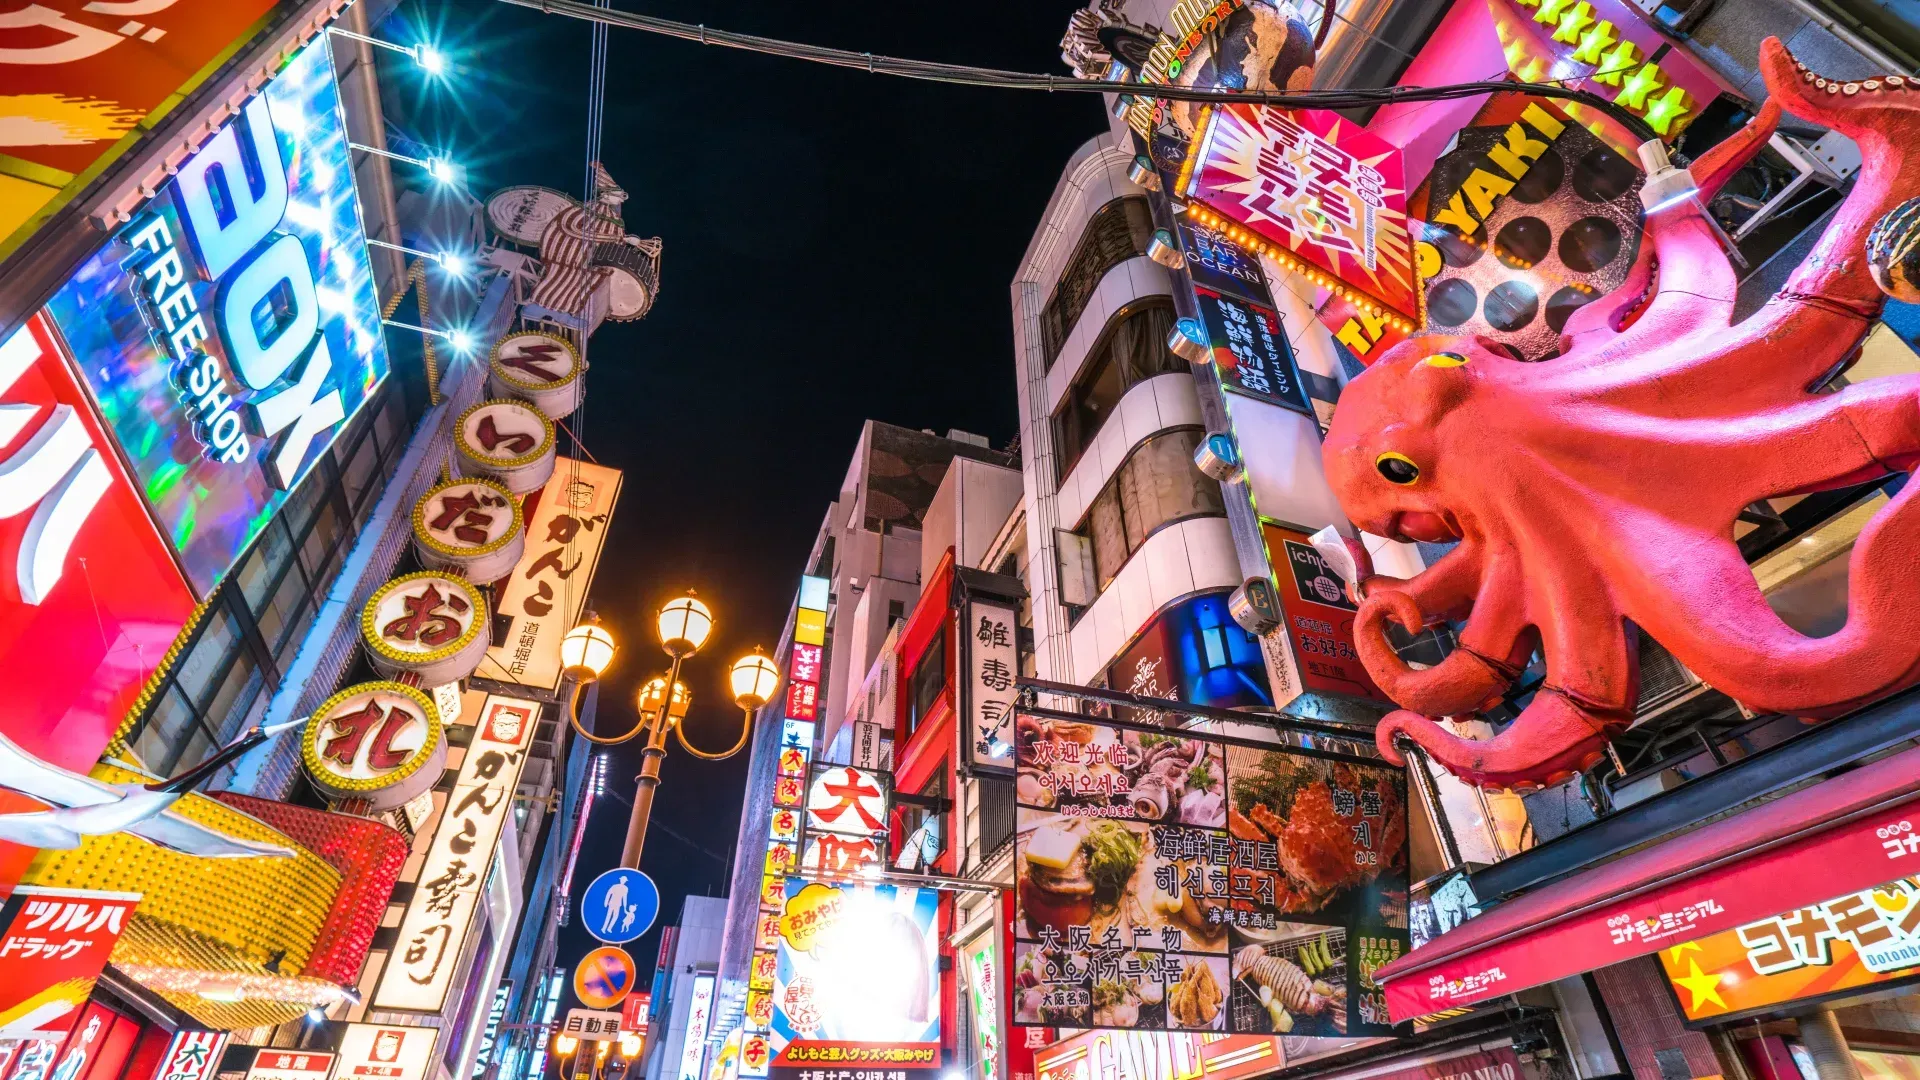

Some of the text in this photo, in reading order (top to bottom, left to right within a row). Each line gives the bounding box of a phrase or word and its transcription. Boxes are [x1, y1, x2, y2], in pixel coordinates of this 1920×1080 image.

[1196, 238, 1240, 260] BAR
[1186, 251, 1261, 284] OCEAN
[131, 215, 251, 465] FREE SHOP
[522, 512, 609, 617] がんこ
[508, 621, 541, 676] 道頓堀店
[785, 722, 795, 730] 6F
[1033, 741, 1128, 765] 欢迎光临
[1038, 771, 1133, 797] 어서오세요
[1061, 805, 1135, 819] いらっしゃいませ
[1333, 789, 1382, 817] 螃蟹
[1354, 851, 1377, 866] かに
[1154, 864, 1276, 906] 해선호프집
[25, 901, 126, 935] ツルハ
[1610, 899, 1725, 945] コナモンミュージアム
[0, 937, 93, 960] ドラッグ
[1038, 925, 1183, 952] 大阪名产物
[1866, 943, 1920, 967] Dotonb
[1042, 991, 1090, 1007] 大阪名物
[566, 1016, 620, 1035] 自動車
[277, 1055, 310, 1070] 地階
